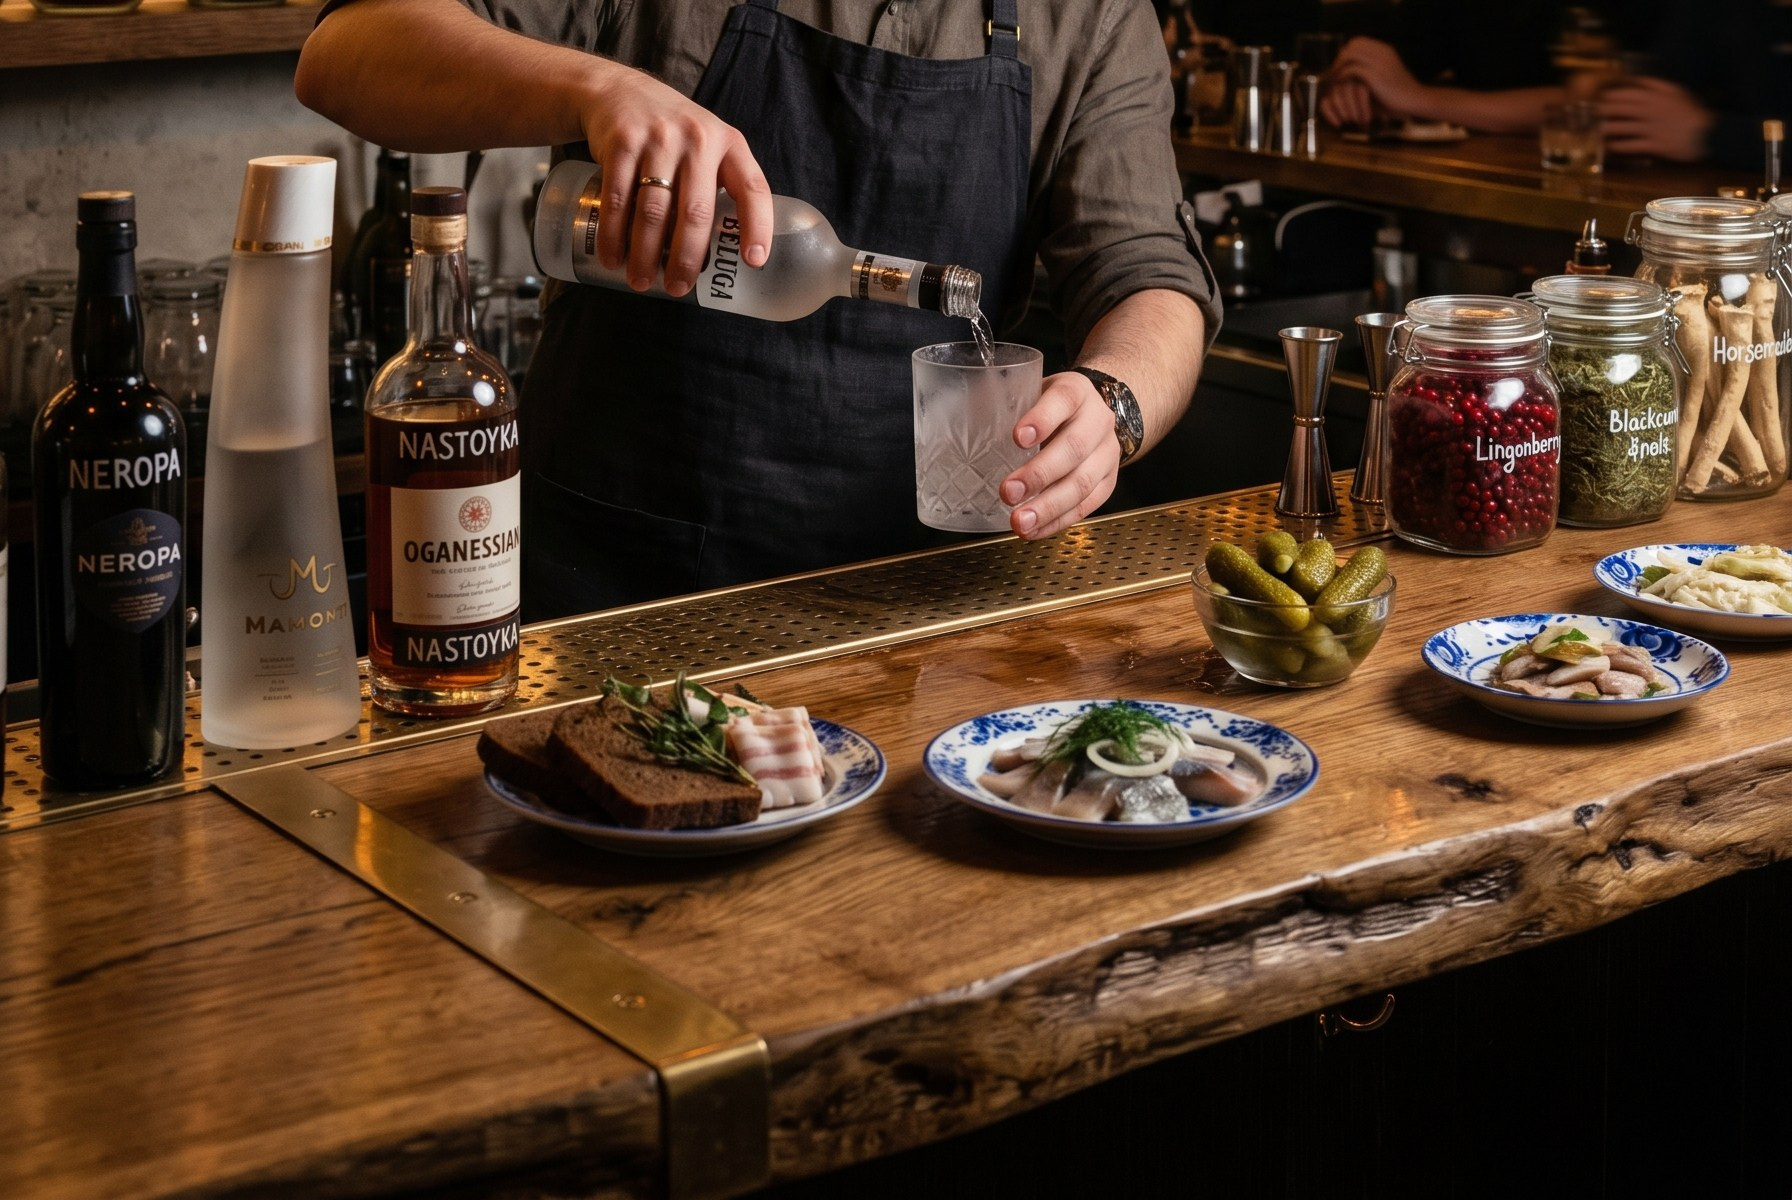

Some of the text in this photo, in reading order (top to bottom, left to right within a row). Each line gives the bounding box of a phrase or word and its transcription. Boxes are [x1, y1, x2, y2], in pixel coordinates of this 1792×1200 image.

[400, 419, 519, 460] NASTOYKA
[69, 447, 181, 490] NEROPA
[78, 542, 181, 574] NEROPA
[404, 525, 519, 563] OGANESSIAN
[407, 622, 518, 662] NASTOYKA
